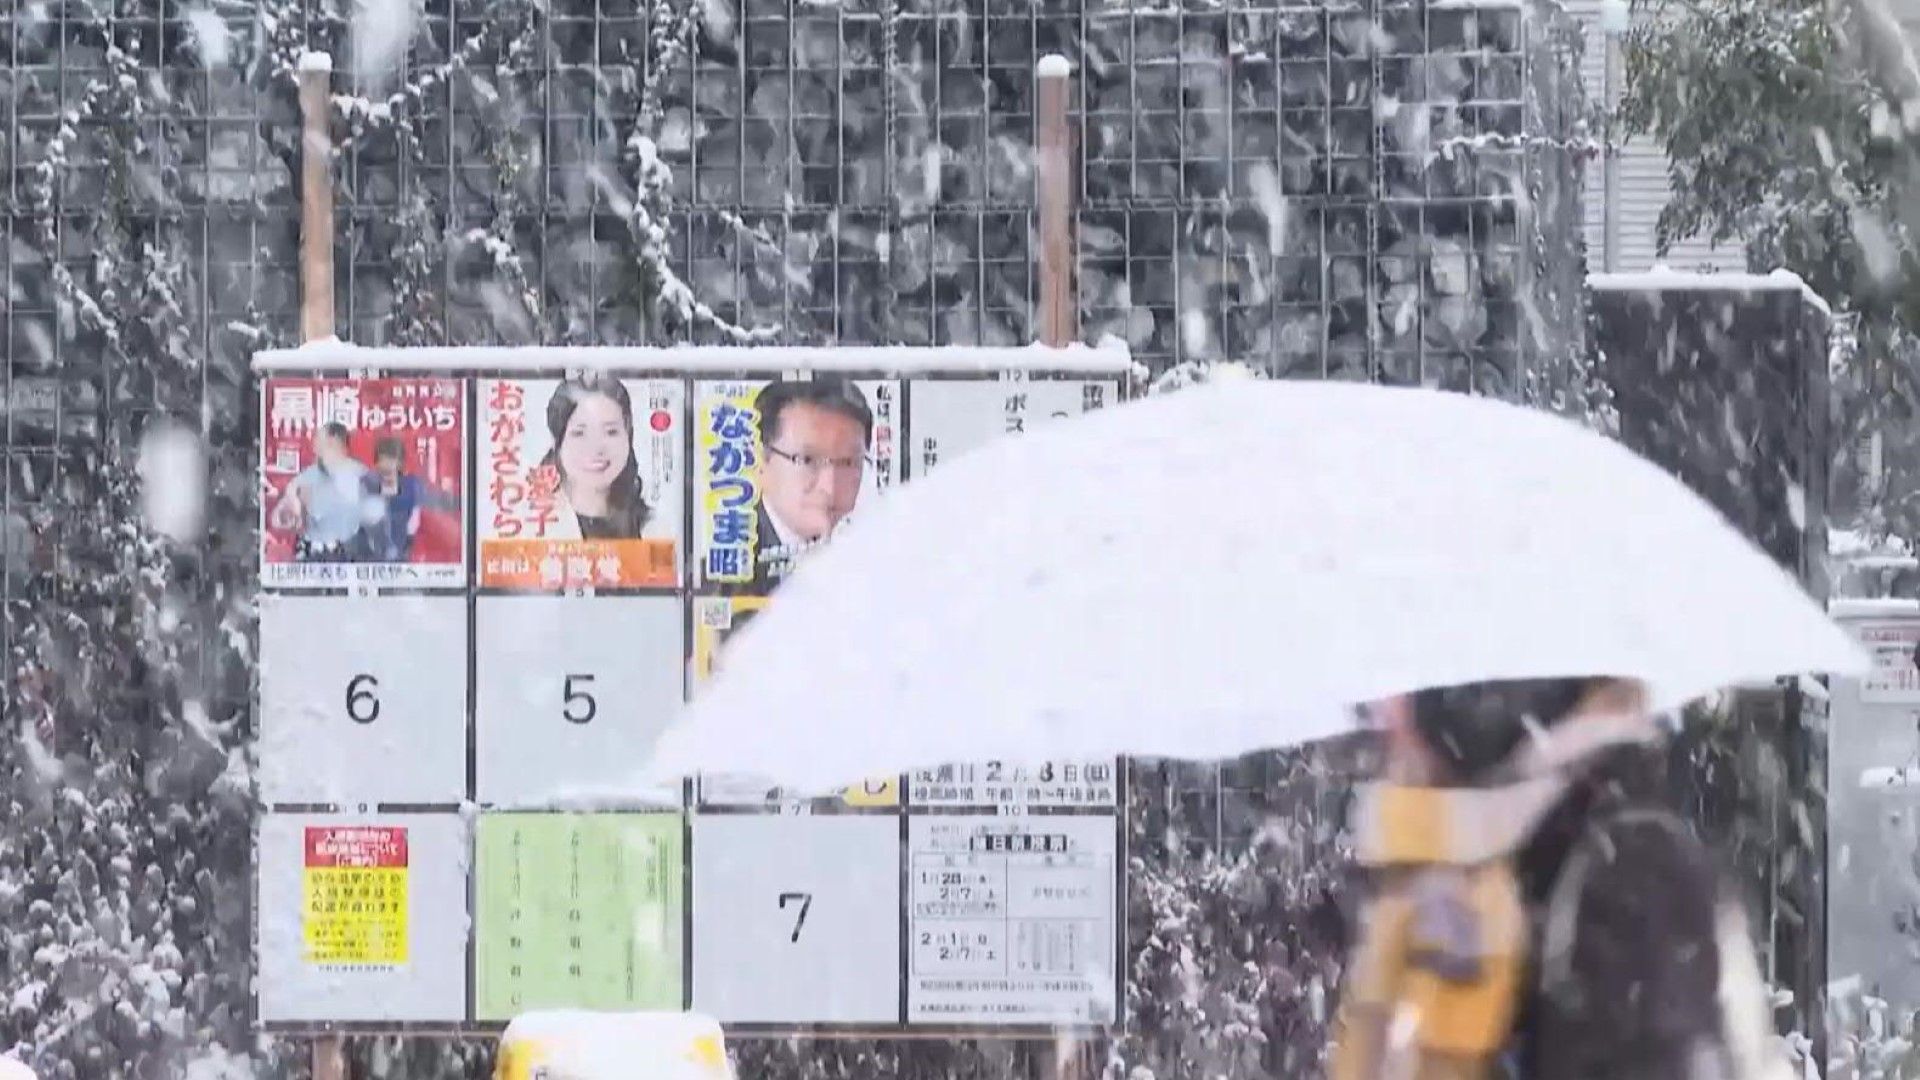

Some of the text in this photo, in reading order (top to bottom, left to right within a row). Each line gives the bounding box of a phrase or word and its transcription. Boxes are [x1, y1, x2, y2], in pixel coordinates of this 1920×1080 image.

[271, 385, 457, 441] 黒崎 ゆういち
[490, 380, 526, 538] おがさわら
[526, 463, 561, 538] 愛子
[347, 674, 380, 724] 6
[563, 674, 596, 724] 5
[1003, 804, 1021, 815] 10
[779, 893, 812, 943] 7
